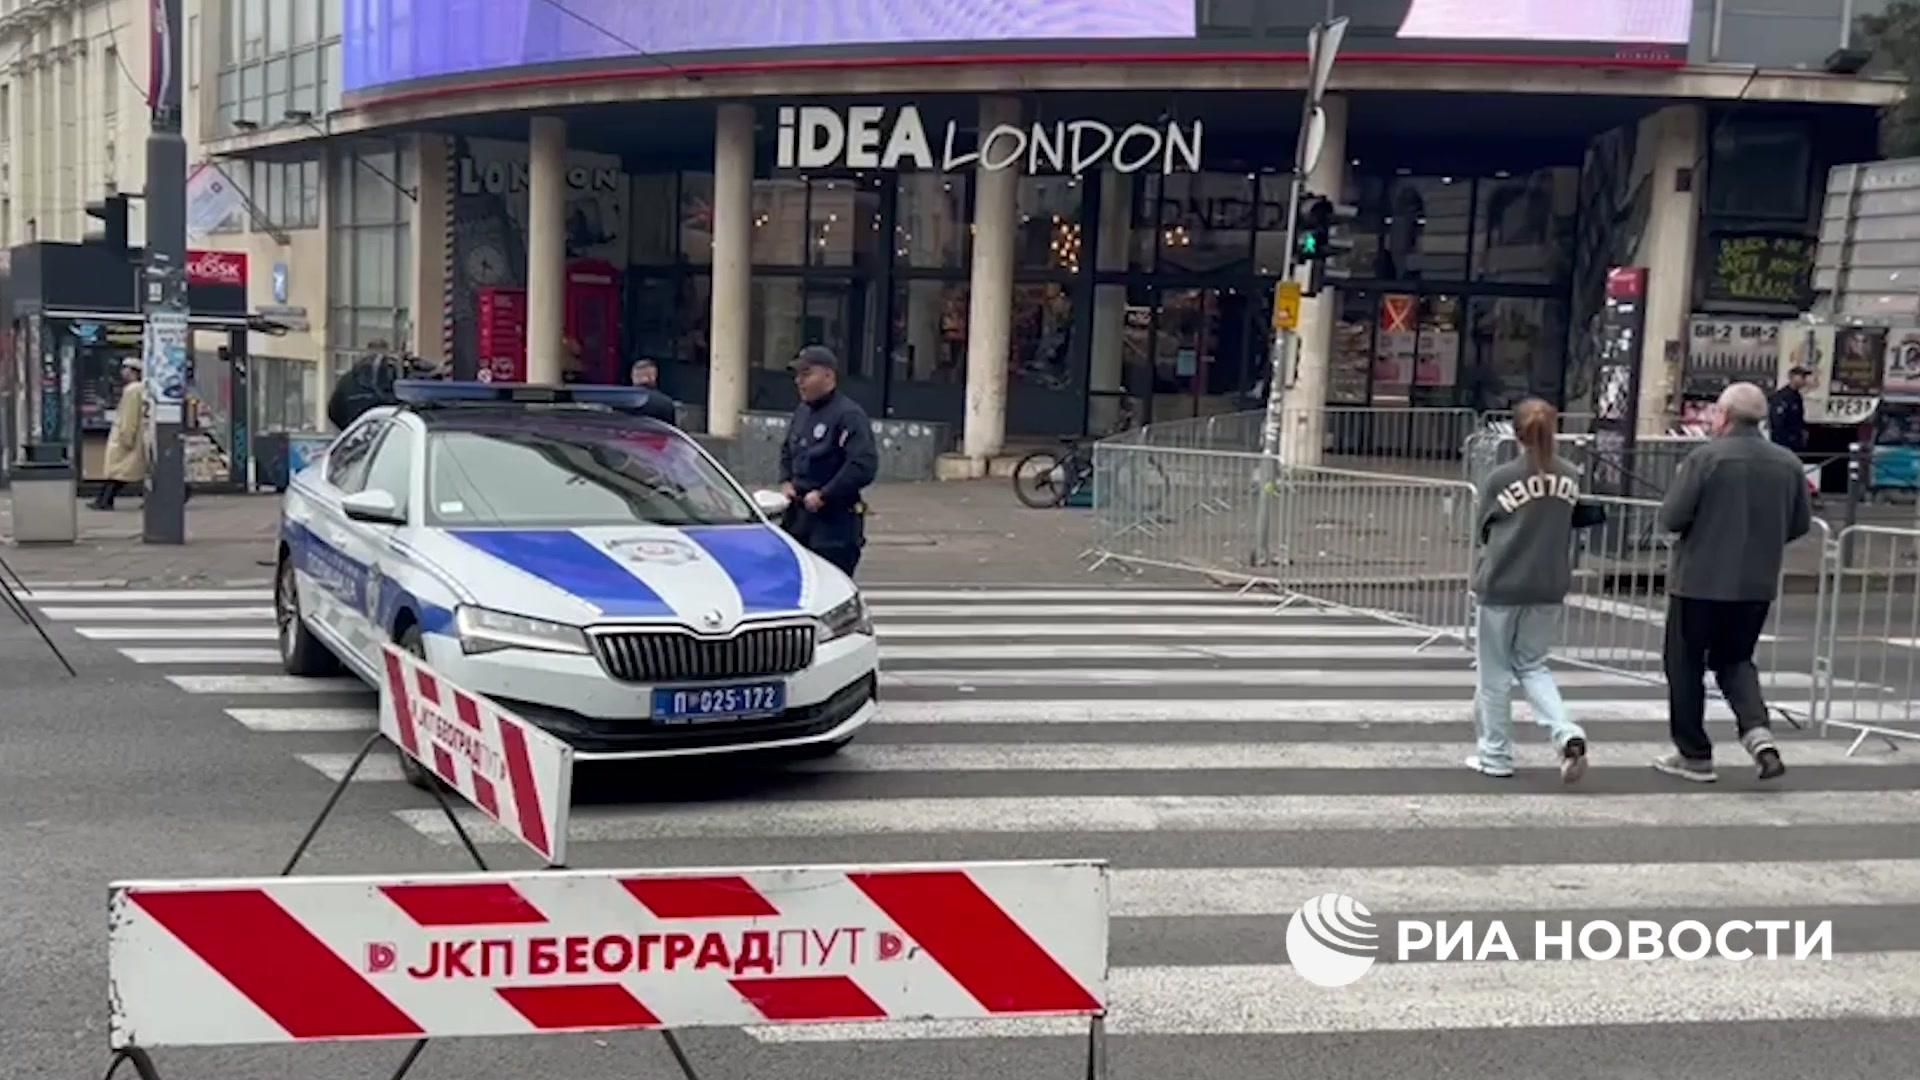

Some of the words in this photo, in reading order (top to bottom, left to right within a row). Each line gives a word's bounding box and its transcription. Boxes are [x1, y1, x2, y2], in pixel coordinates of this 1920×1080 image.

[777, 106, 934, 168] iDEA
[942, 119, 1203, 175] LONDON
[460, 157, 618, 194] LONON
[700, 686, 775, 713] 025-172
[527, 928, 866, 976] БЕОГРАДПУТ
